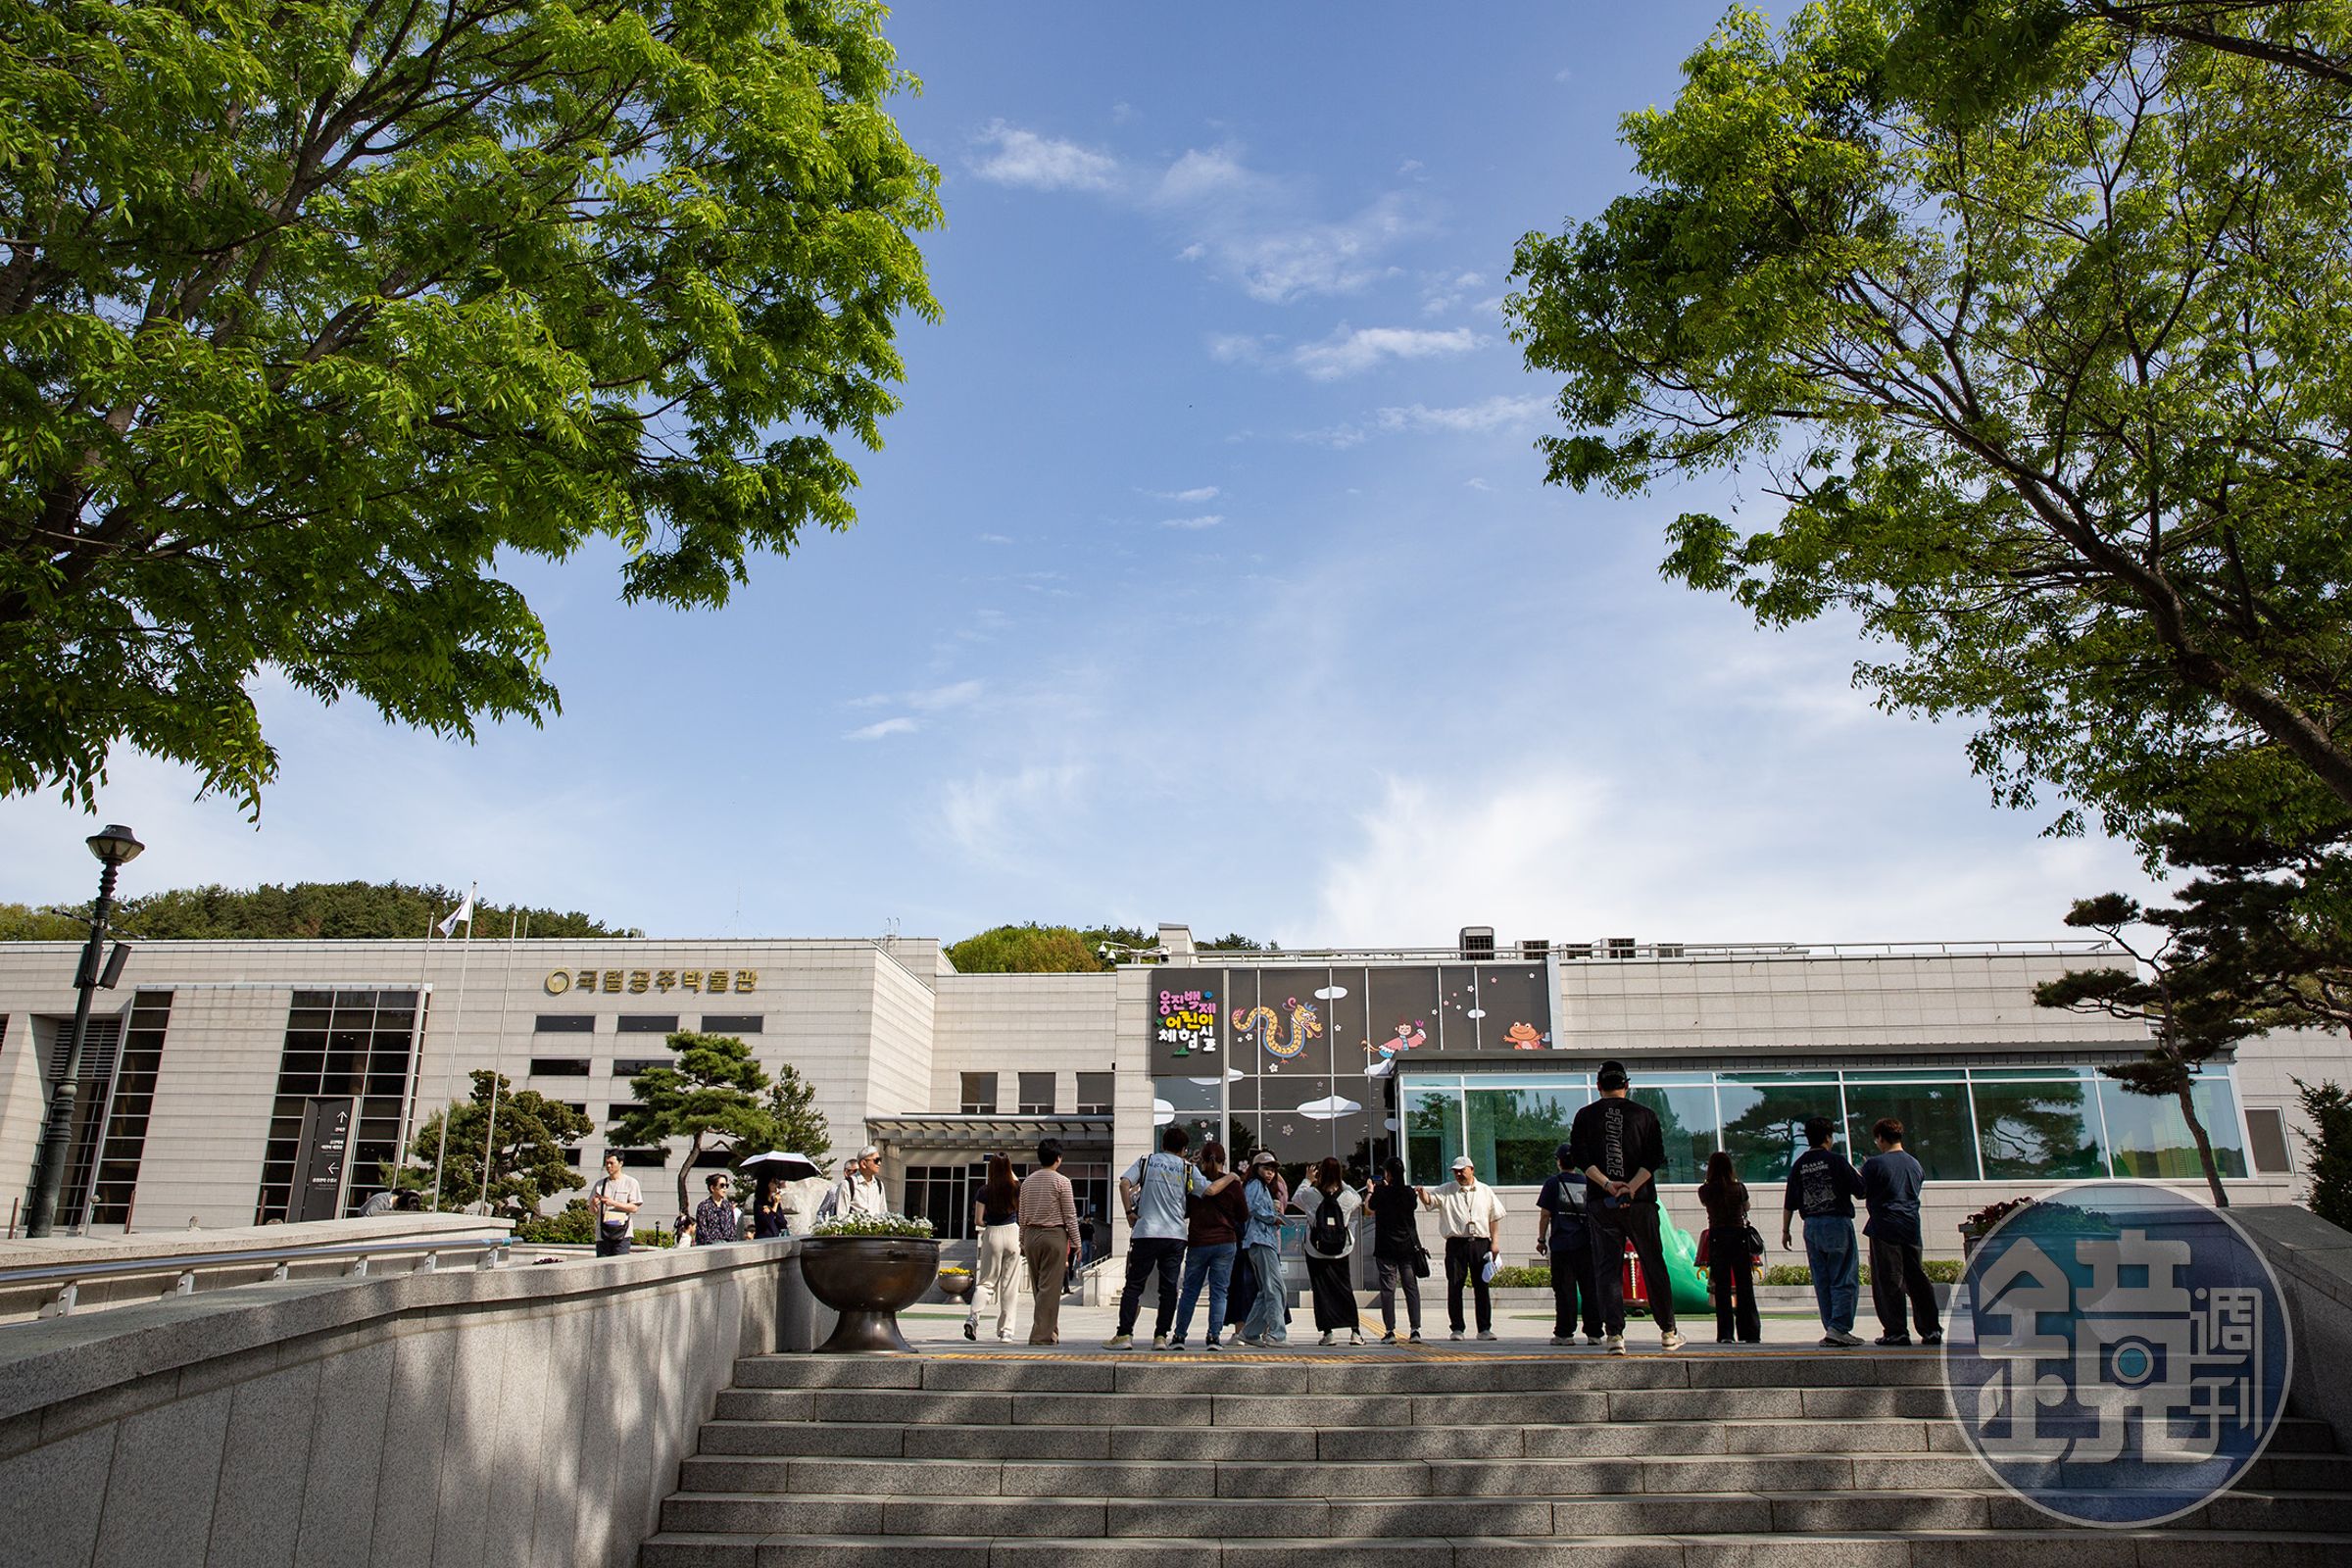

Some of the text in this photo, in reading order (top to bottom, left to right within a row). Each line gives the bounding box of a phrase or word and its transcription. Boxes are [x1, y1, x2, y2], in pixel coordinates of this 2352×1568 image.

[576, 969, 759, 994] 국립공주박물관
[1159, 990, 1216, 1015] 웅진백제
[1165, 1010, 1213, 1029] 어린이
[1158, 1025, 1216, 1052] 체험실
